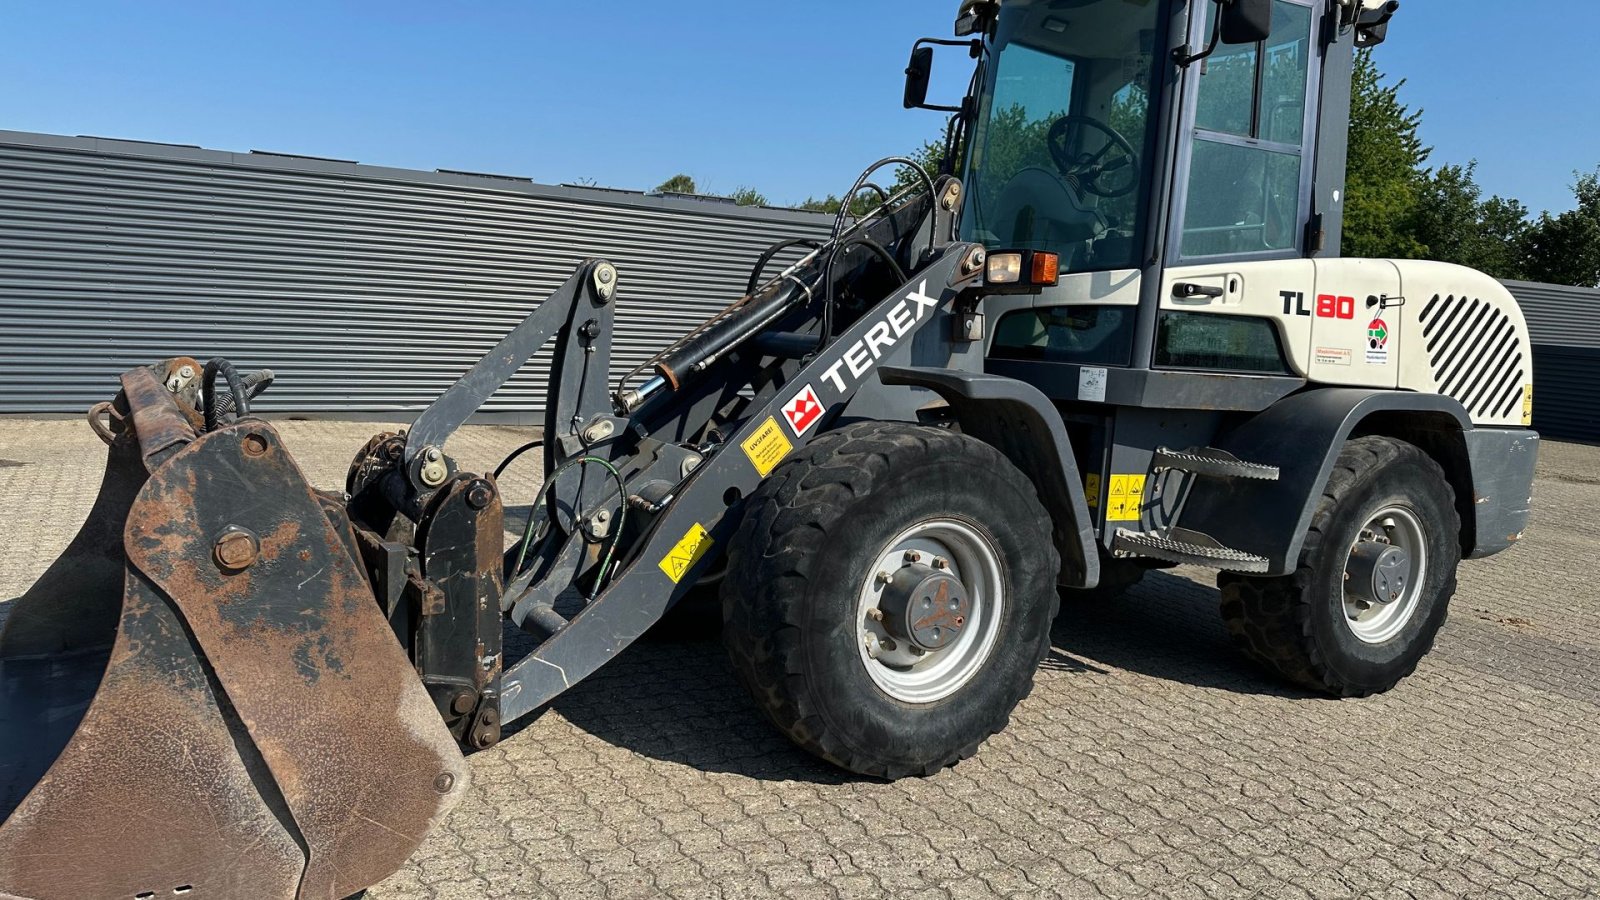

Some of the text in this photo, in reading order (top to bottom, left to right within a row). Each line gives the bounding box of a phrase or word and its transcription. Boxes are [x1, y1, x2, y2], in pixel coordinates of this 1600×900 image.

[820, 278, 938, 394] TEREX
[1279, 290, 1355, 320] TL 80
